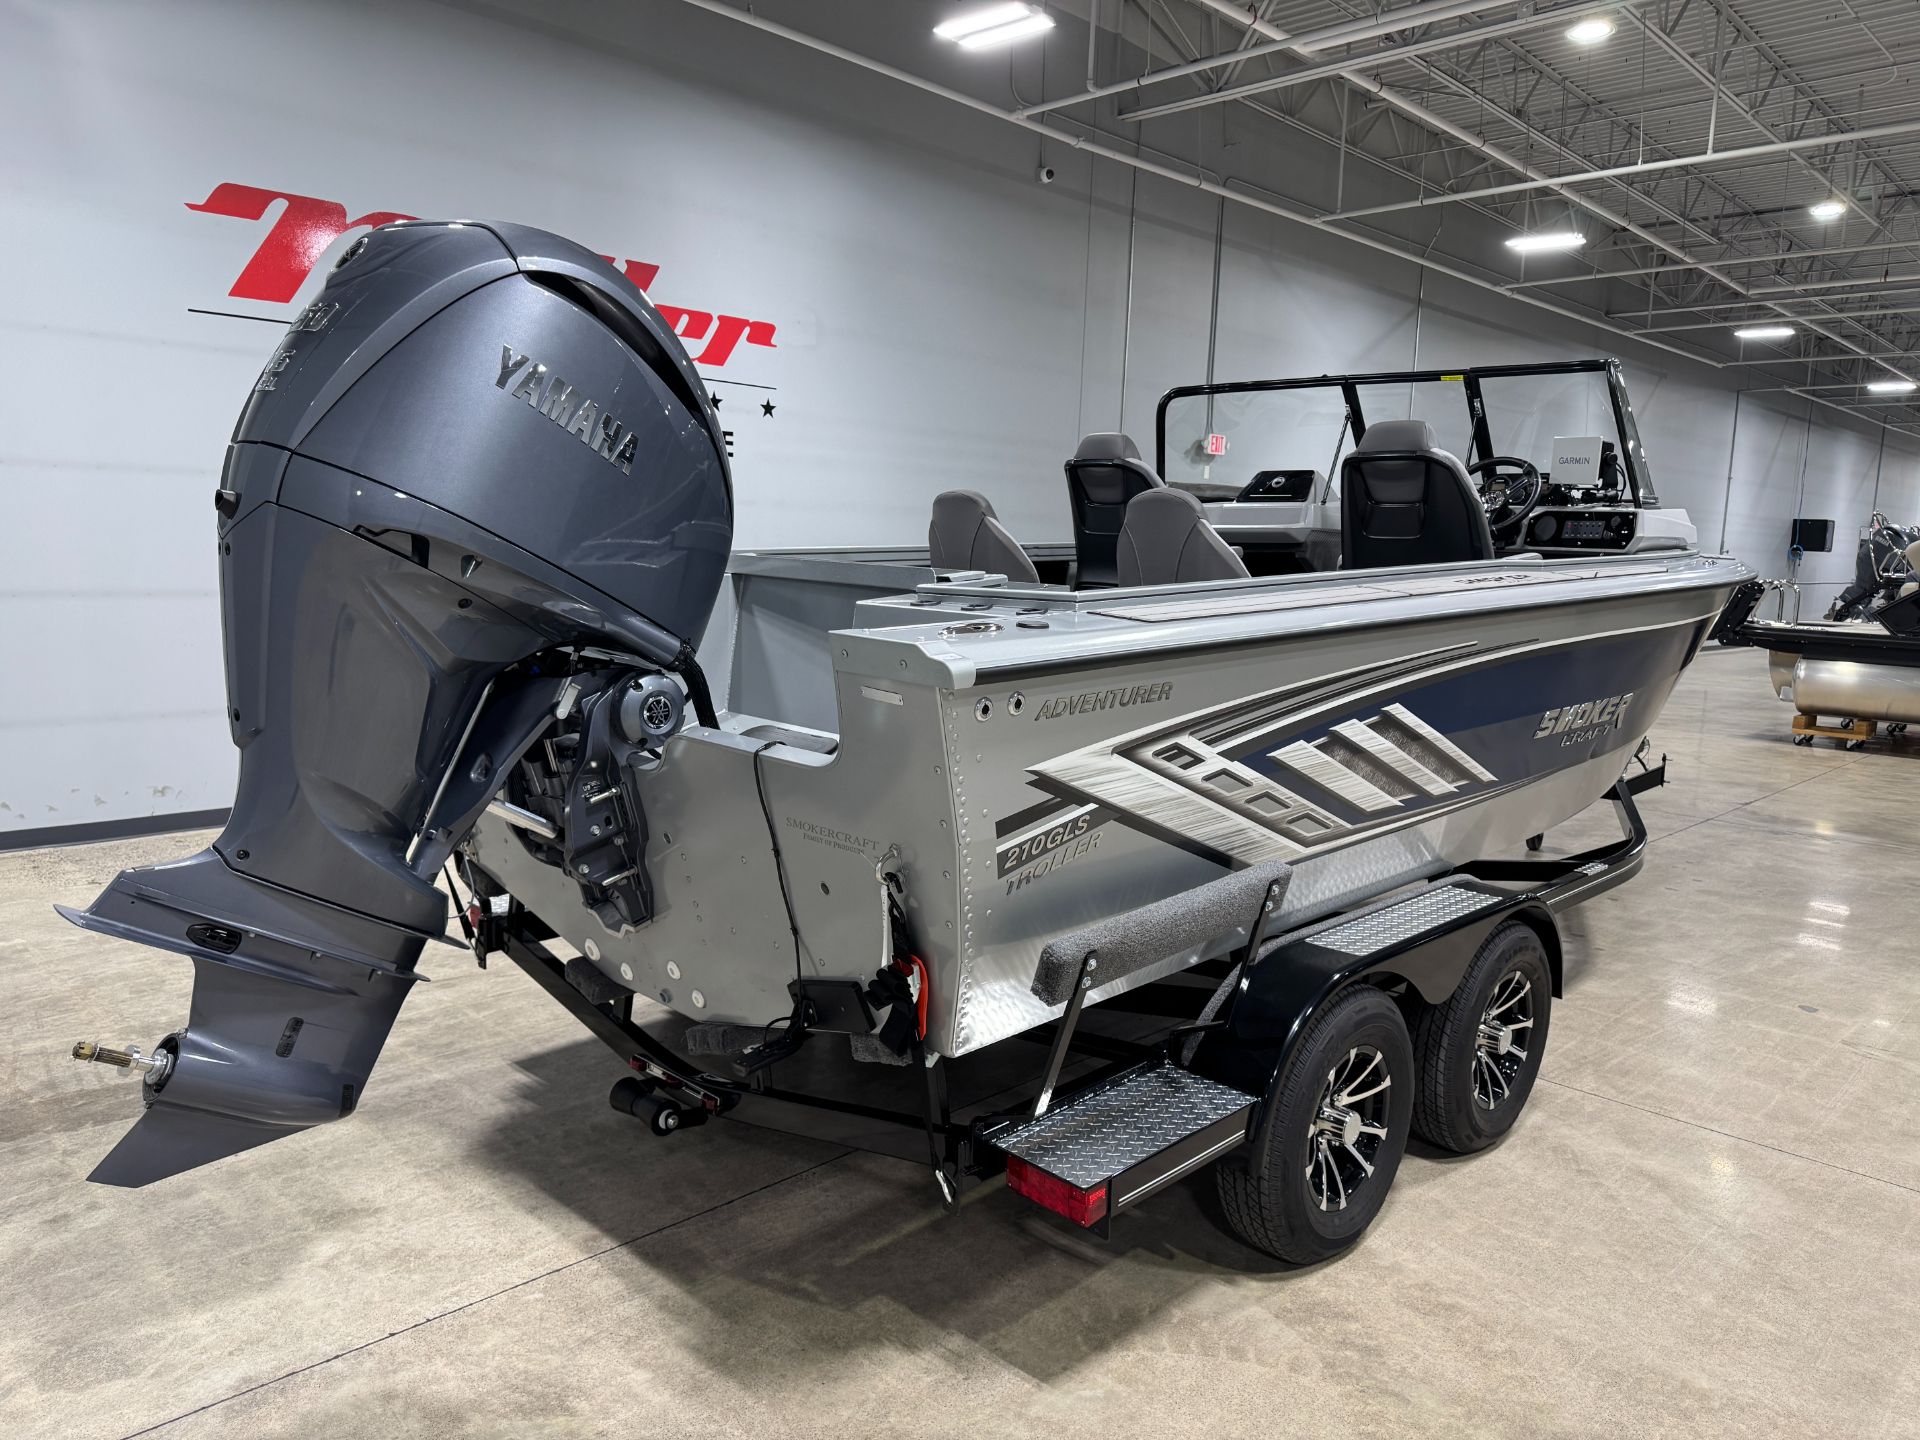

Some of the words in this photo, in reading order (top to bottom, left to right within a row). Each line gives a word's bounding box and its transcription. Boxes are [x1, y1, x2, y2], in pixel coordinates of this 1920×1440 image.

[495, 343, 640, 476] YAMAHA
[1211, 435, 1224, 453] EXIT
[1558, 456, 1591, 465] GARMIN
[1034, 681, 1174, 722] ADVENTURER
[1533, 692, 1635, 740] SMOKER
[1560, 724, 1613, 748] CRAFT
[785, 816, 880, 850] SMOKERCRAFT
[1006, 831, 1104, 897] TROLLER
